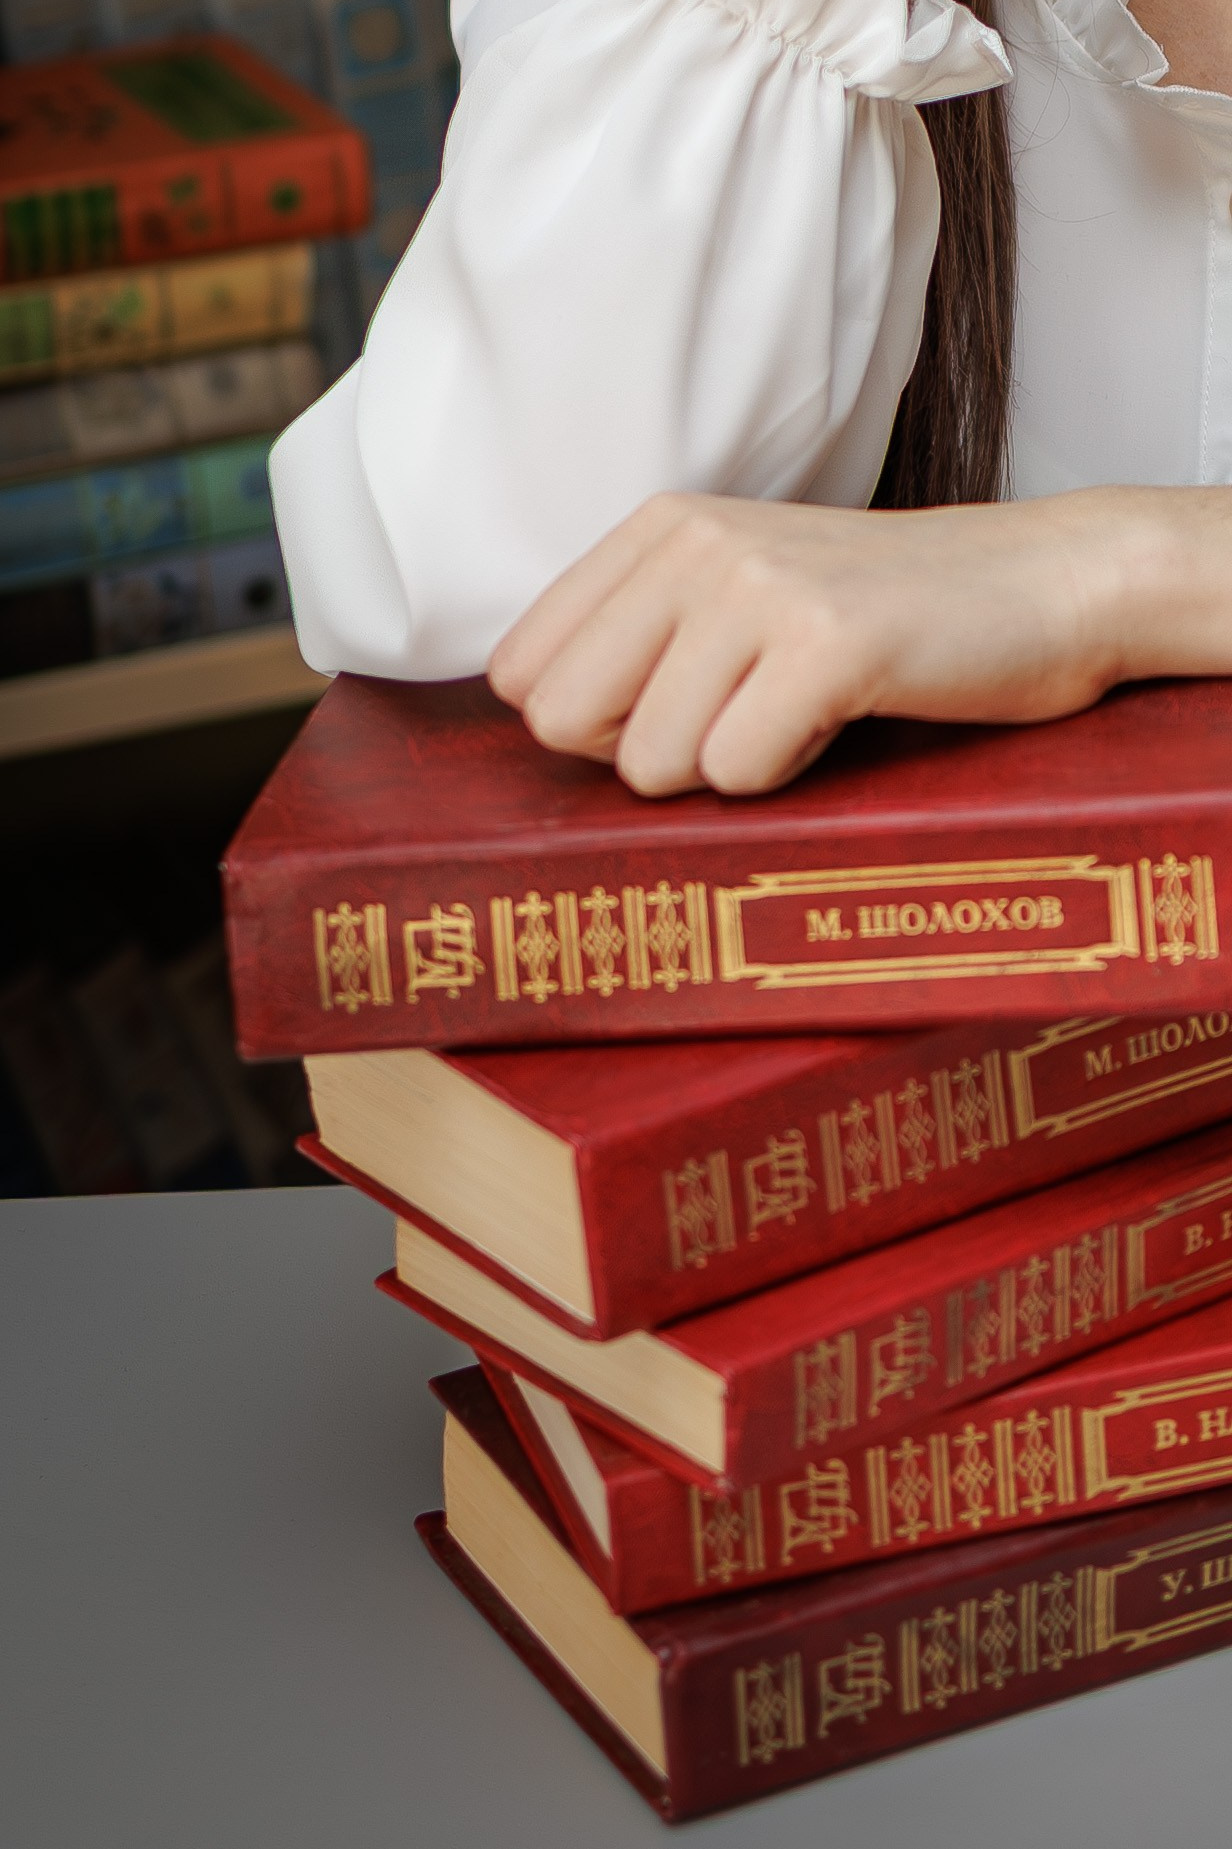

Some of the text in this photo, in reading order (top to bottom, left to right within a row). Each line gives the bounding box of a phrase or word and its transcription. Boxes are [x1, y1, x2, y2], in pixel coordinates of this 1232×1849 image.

[805, 895, 1065, 942] М. ШОЛОХОВ
[1084, 1044, 1123, 1081] М.
[1184, 1223, 1214, 1256] В.
[1154, 1418, 1189, 1451] В.
[1160, 1568, 1194, 1601] У.
